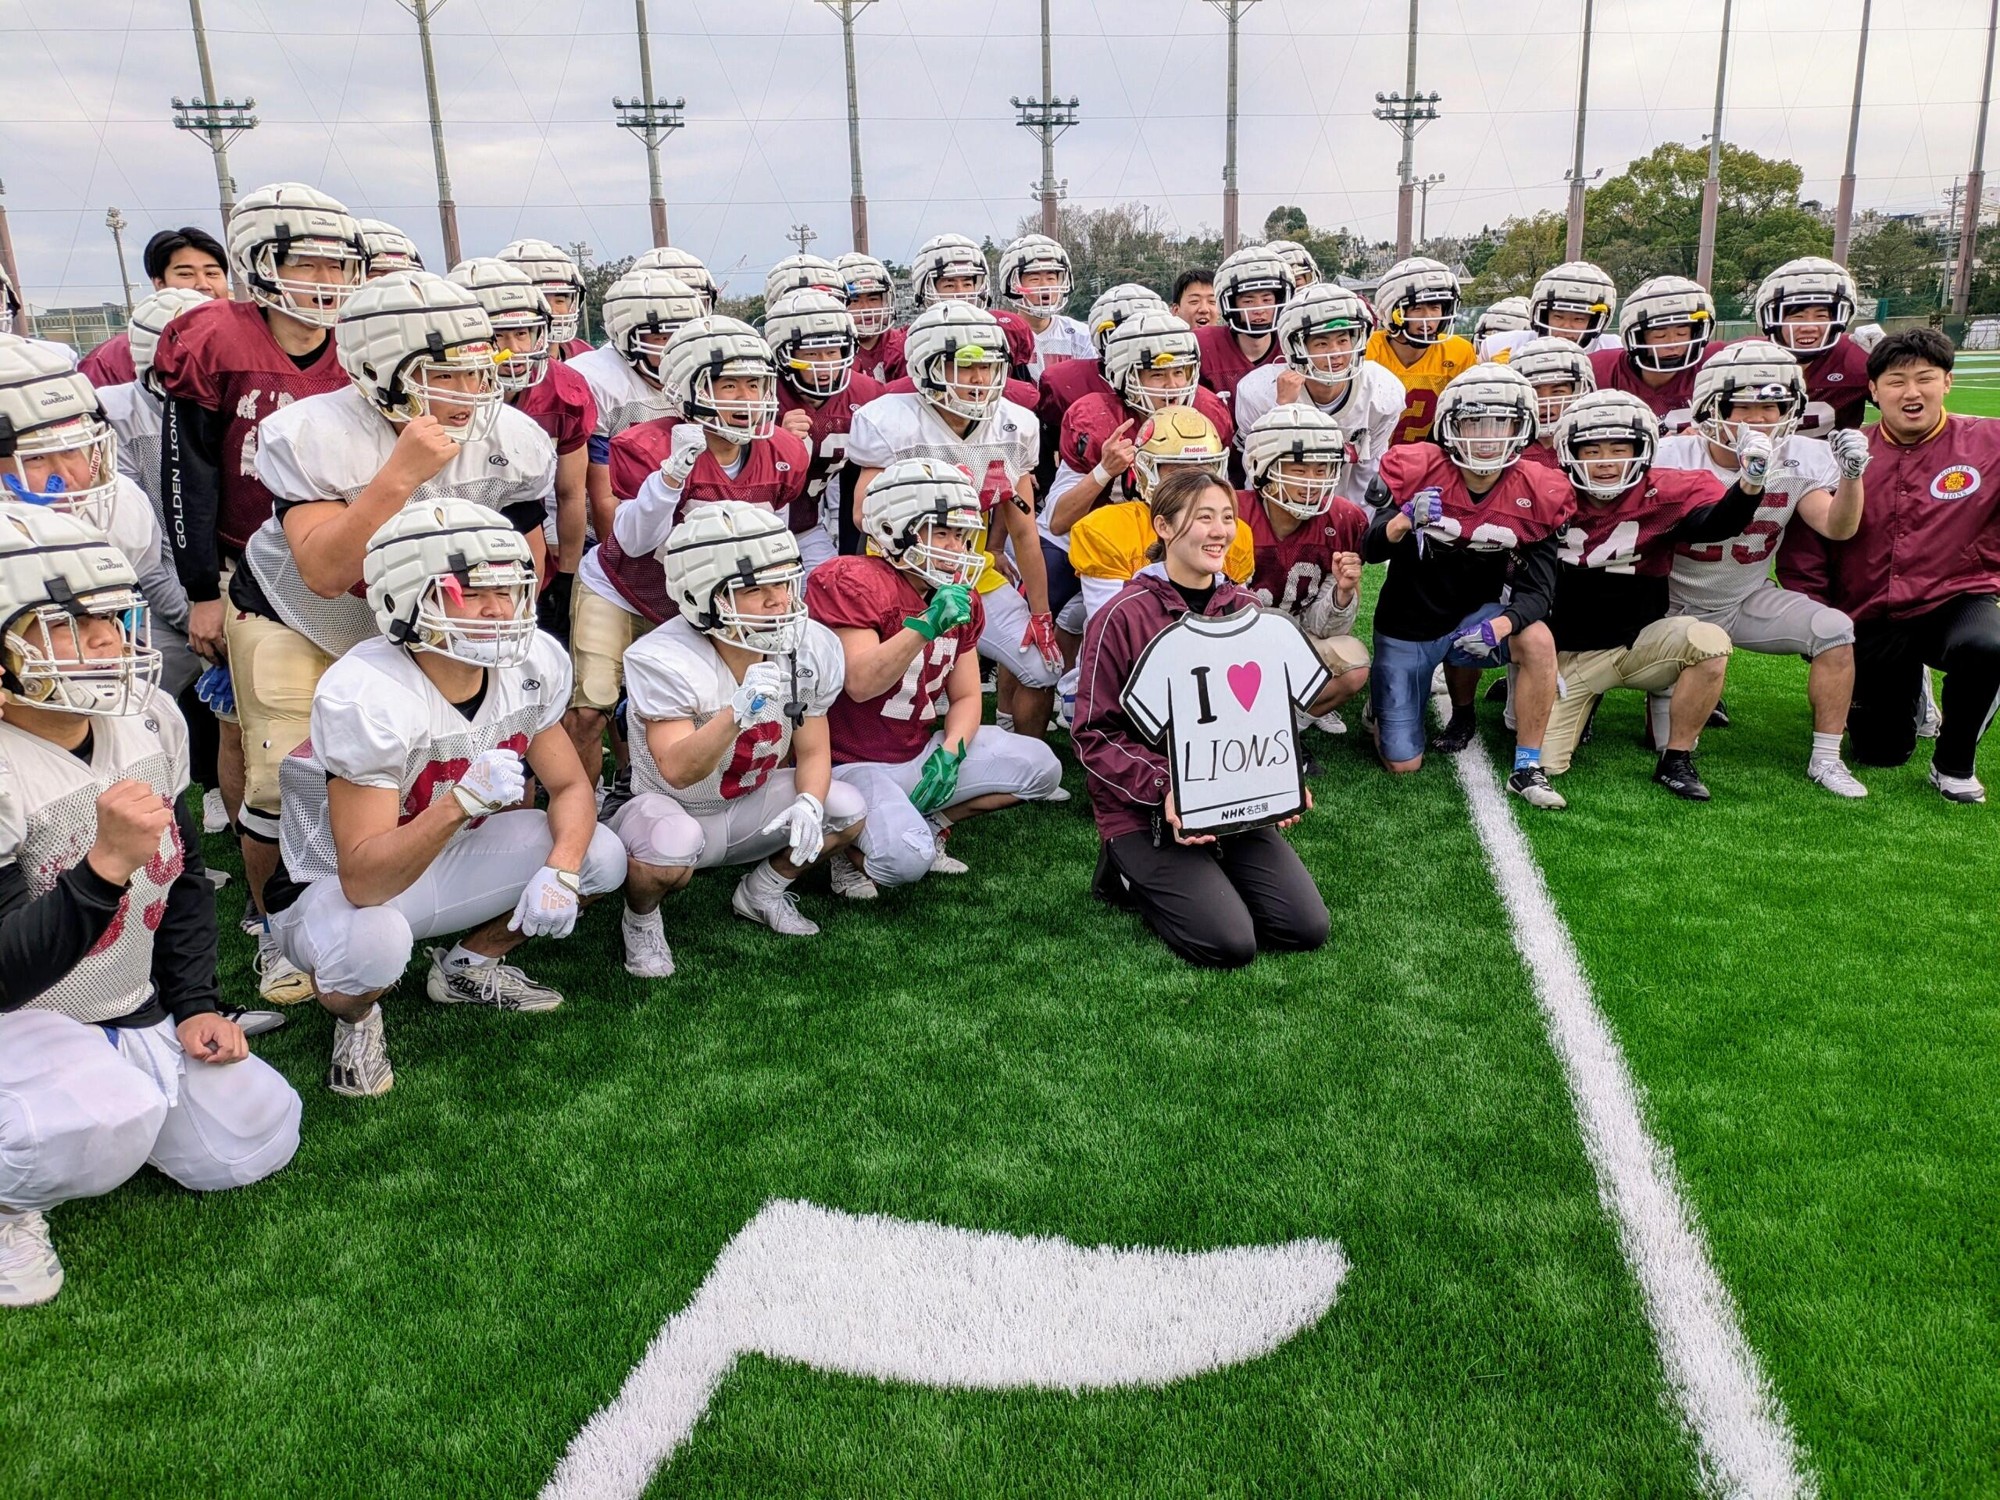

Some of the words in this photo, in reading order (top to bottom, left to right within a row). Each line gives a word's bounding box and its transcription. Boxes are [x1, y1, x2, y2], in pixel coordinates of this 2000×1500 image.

[41, 394, 74, 406] GUARDIAN
[170, 401, 180, 462] LIONS
[1941, 466, 1971, 476] GOLDEN
[1942, 491, 1967, 499] LIONS
[172, 469, 187, 549] GOLDEN
[1190, 666, 1218, 725] I
[1184, 729, 1290, 782] LIONS
